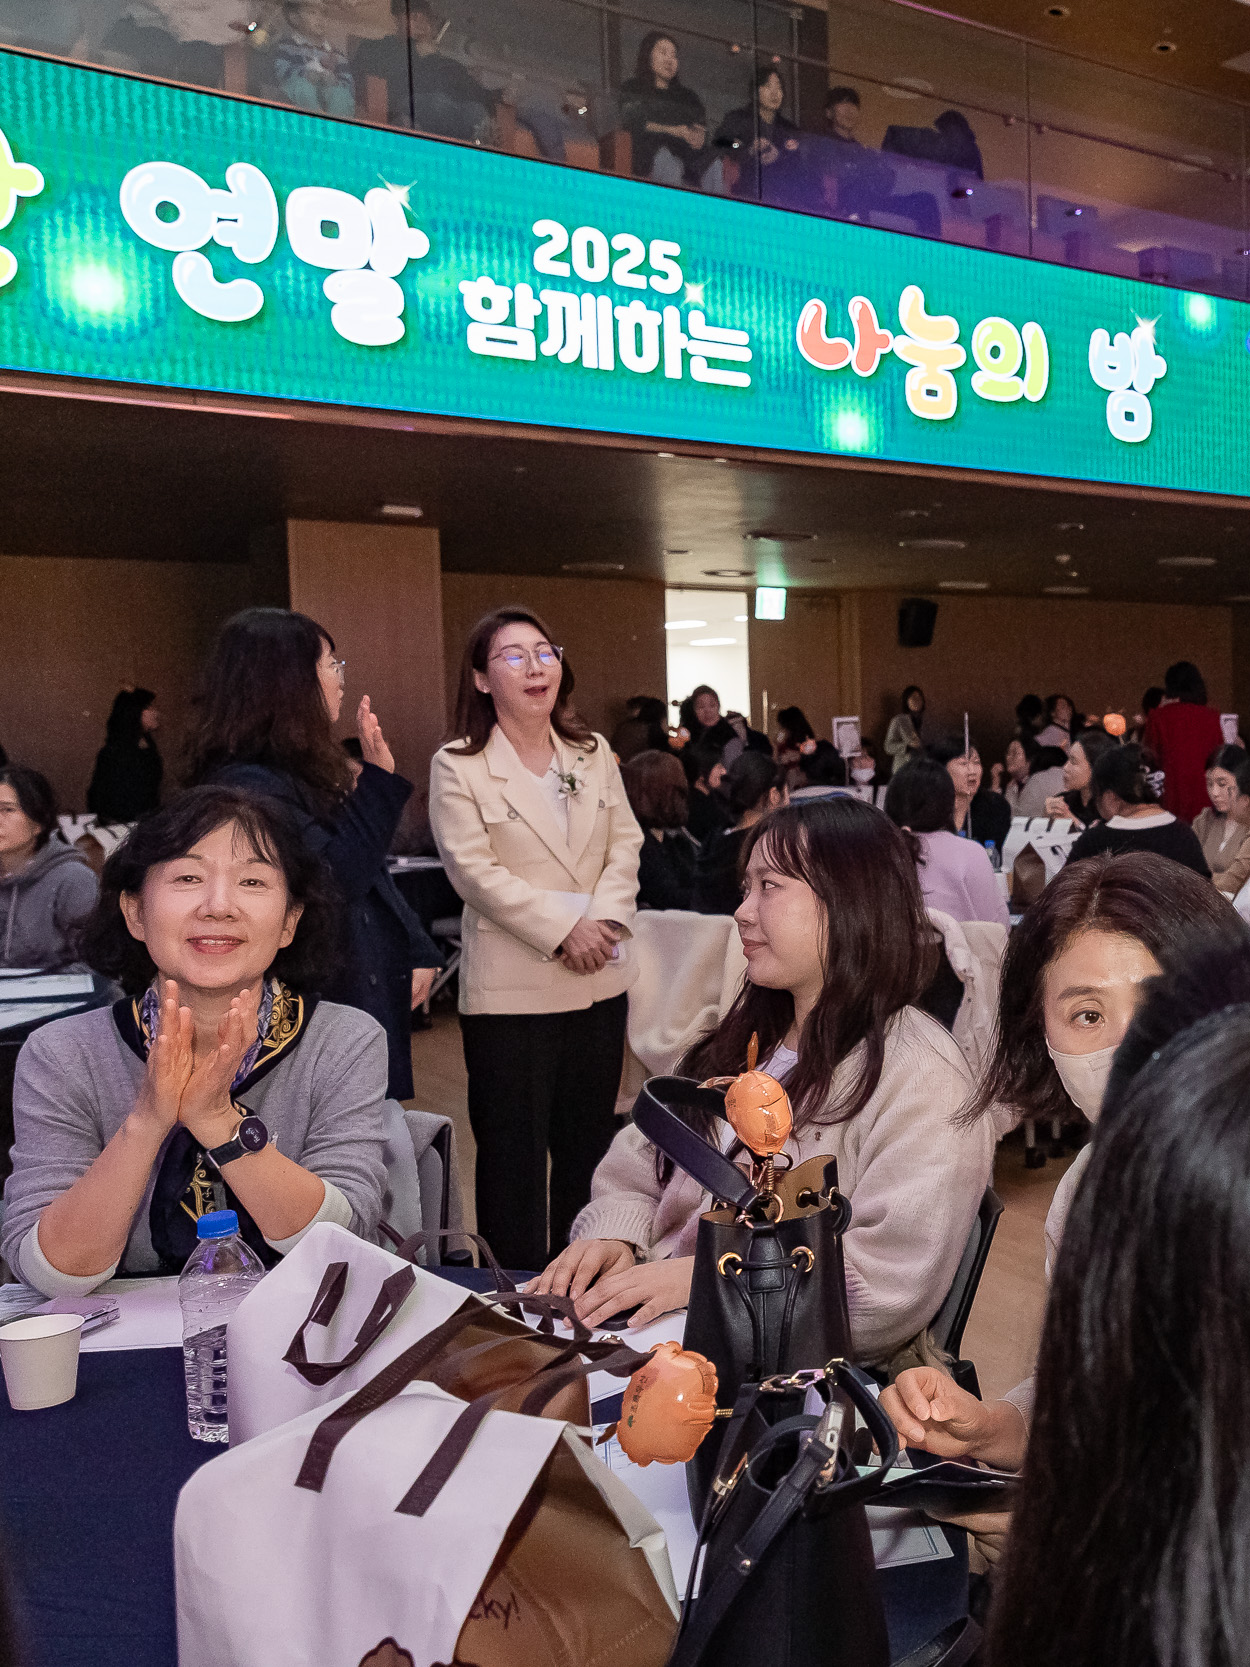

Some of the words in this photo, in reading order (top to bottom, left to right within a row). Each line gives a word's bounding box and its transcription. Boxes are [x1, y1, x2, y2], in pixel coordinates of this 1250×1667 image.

[118, 160, 431, 347] 연말
[531, 218, 686, 295] 2025
[457, 275, 754, 389] 함께하는
[796, 284, 1050, 421] 나눔의
[1088, 323, 1168, 444] 방
